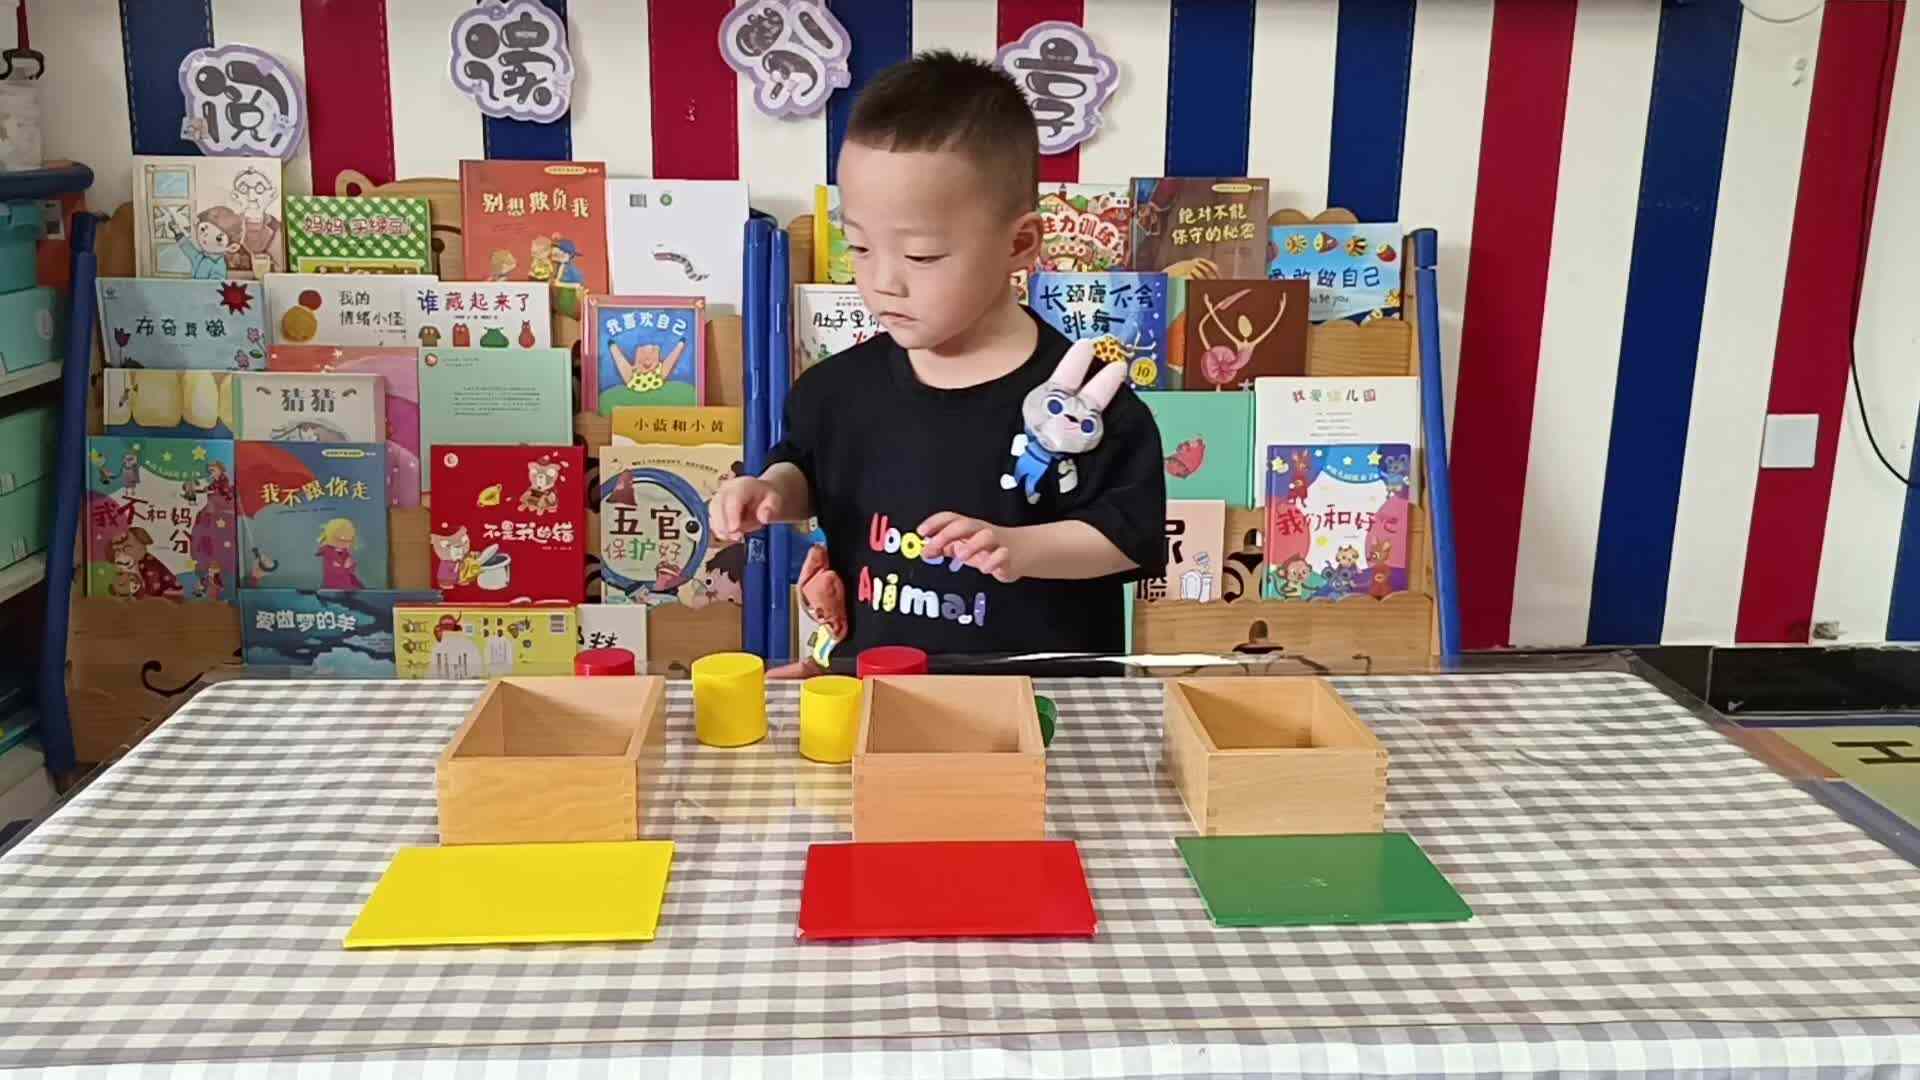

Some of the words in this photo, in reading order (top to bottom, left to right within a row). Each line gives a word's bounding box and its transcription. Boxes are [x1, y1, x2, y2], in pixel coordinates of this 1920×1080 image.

[482, 187, 590, 218] 别想欺负我
[1178, 203, 1247, 225] 绝对不能
[1171, 223, 1256, 246] 保守的秘密
[340, 291, 370, 306] 我的
[417, 289, 529, 315] 谁藏起来了
[1040, 281, 1153, 313] 长颈鹿不会
[340, 311, 405, 327] 情绪小怪
[606, 311, 687, 336] 我喜欢自己
[1062, 308, 1126, 339] 跳舞
[633, 418, 724, 433] 小蓝和小黄
[260, 476, 371, 507] 我不跟你走
[482, 520, 574, 544] 不是我的错
[609, 505, 683, 540] 五官
[605, 539, 682, 561] 保护好
